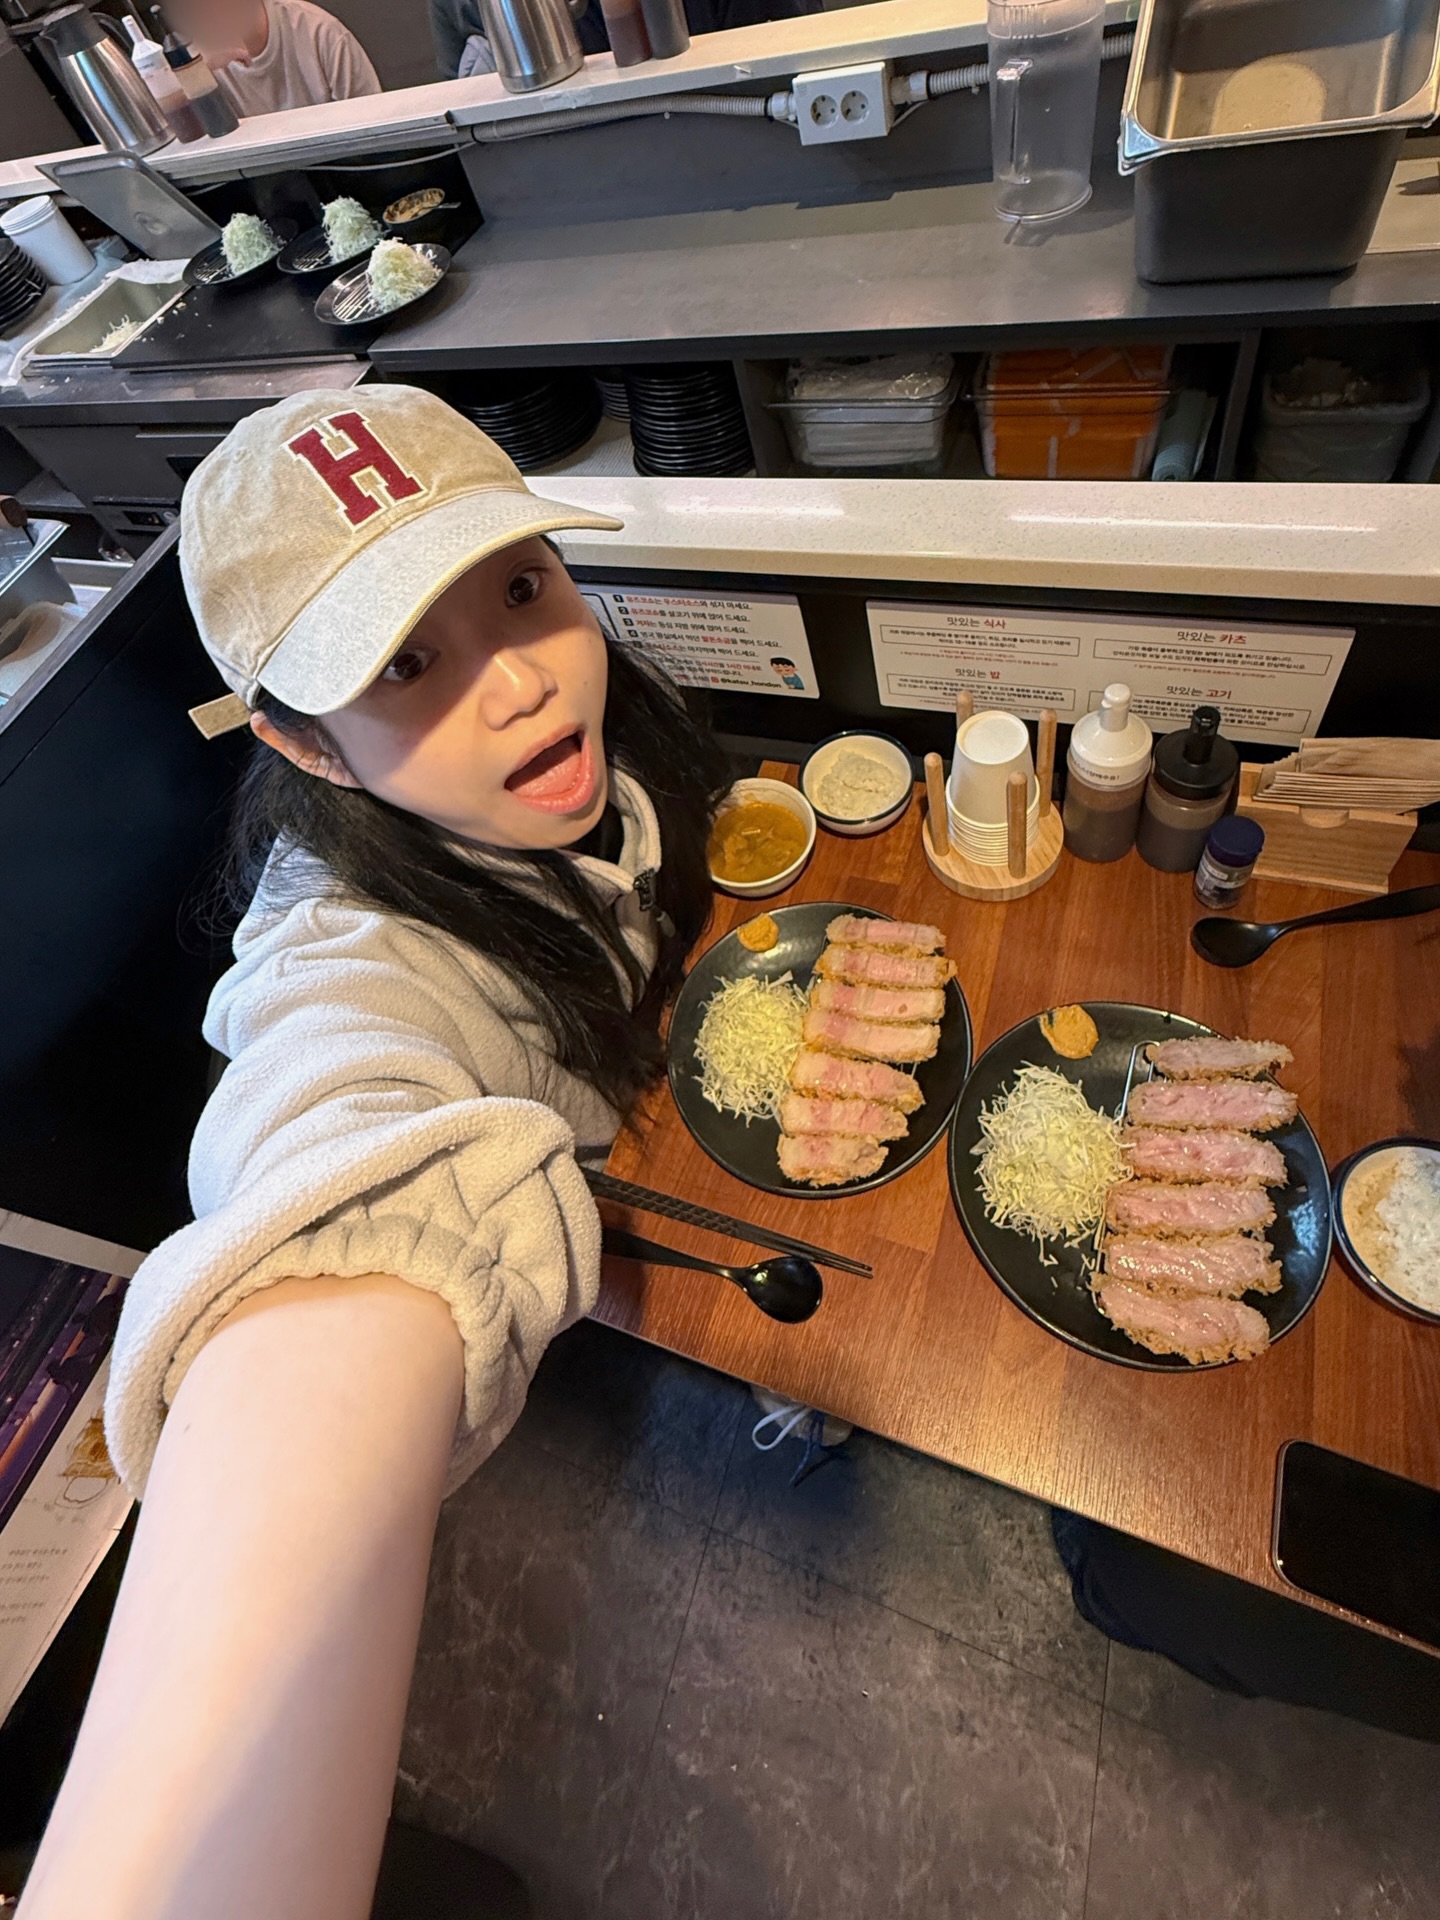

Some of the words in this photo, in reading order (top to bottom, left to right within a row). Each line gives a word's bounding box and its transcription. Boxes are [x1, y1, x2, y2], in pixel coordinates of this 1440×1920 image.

[279, 408, 428, 533] H
[664, 598, 707, 608] 우스터소스와
[726, 601, 753, 610] 마세요.
[668, 610, 690, 618] 살코기
[692, 612, 707, 620] 위에
[725, 614, 751, 622] 드세요.
[635, 620, 657, 628] 겨자는
[724, 625, 749, 634] 드세요.
[947, 616, 981, 628] 맛있는
[983, 619, 1007, 630] 식사
[756, 640, 783, 648] 드세요.
[1176, 630, 1216, 643] 맛있는
[1219, 634, 1248, 645] 카츠
[955, 668, 987, 679] 맛있는
[989, 670, 1001, 680] 밥
[720, 677, 782, 688] @katsu_hondon
[1166, 685, 1204, 697] 맛있는
[1206, 688, 1233, 699] 고기
